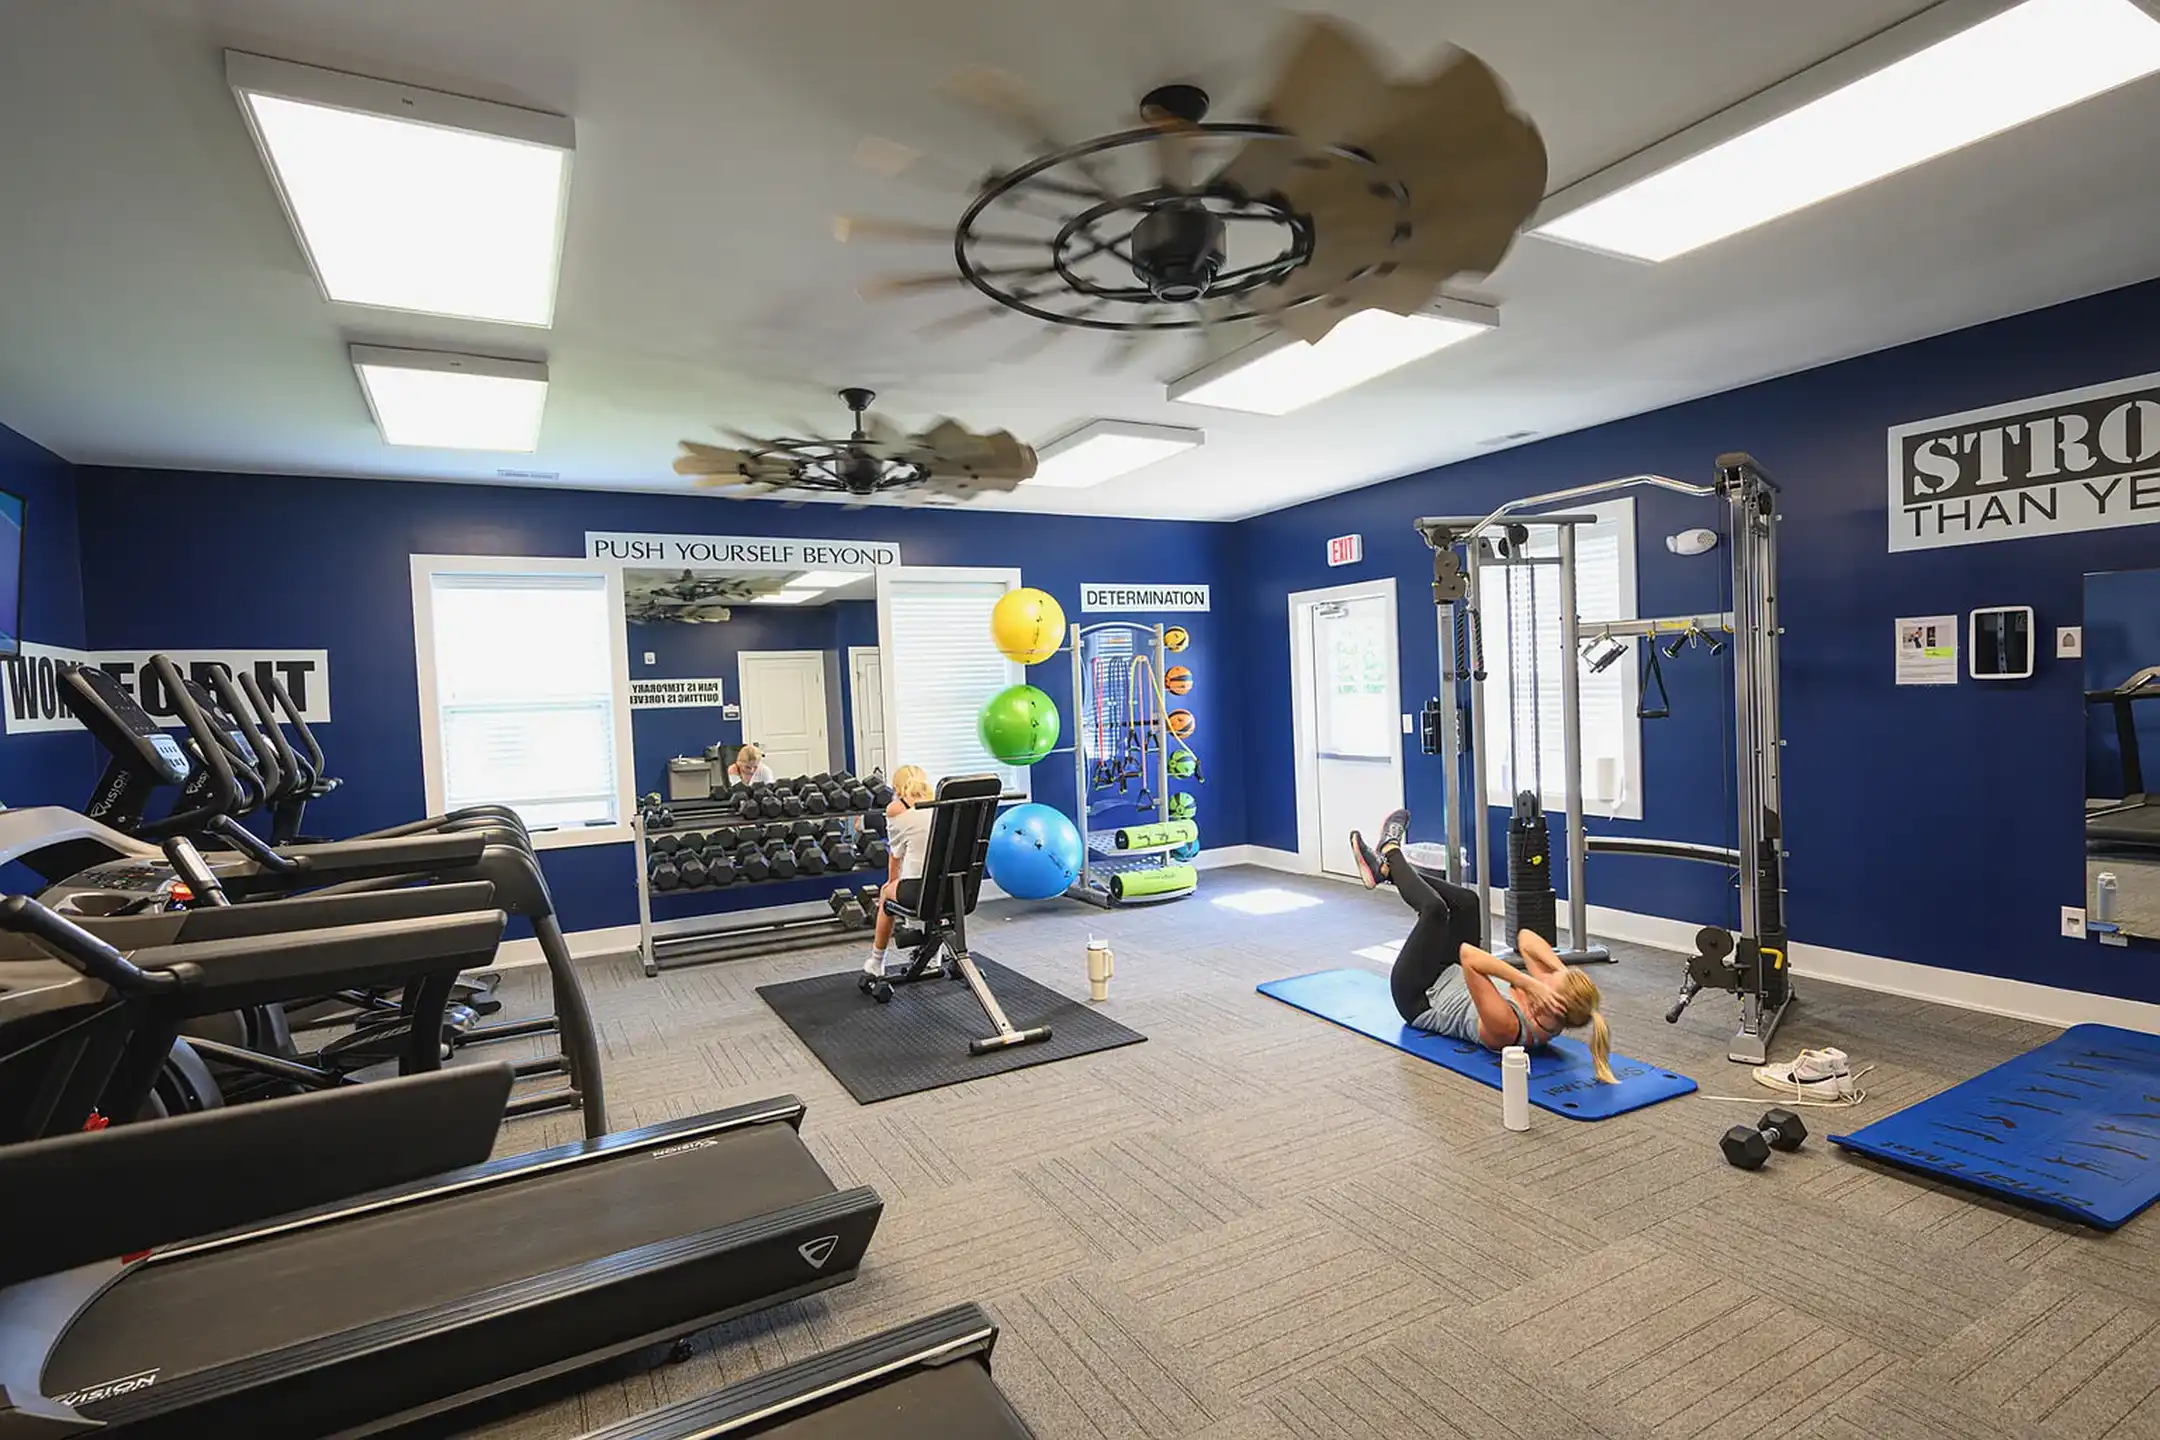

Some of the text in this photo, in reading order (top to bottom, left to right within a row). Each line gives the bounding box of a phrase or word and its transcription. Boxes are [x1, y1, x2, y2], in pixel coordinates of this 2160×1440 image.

[1913, 400, 2160, 496] STRO
[1904, 474, 2160, 537] THAN YE
[595, 539, 894, 566] PUSH YOURSELF BEYOND
[1332, 537, 1354, 563] EXIT
[1086, 590, 1205, 606] DETERMINATION
[103, 769, 129, 809] VISION
[63, 1374, 156, 1405] VISION
